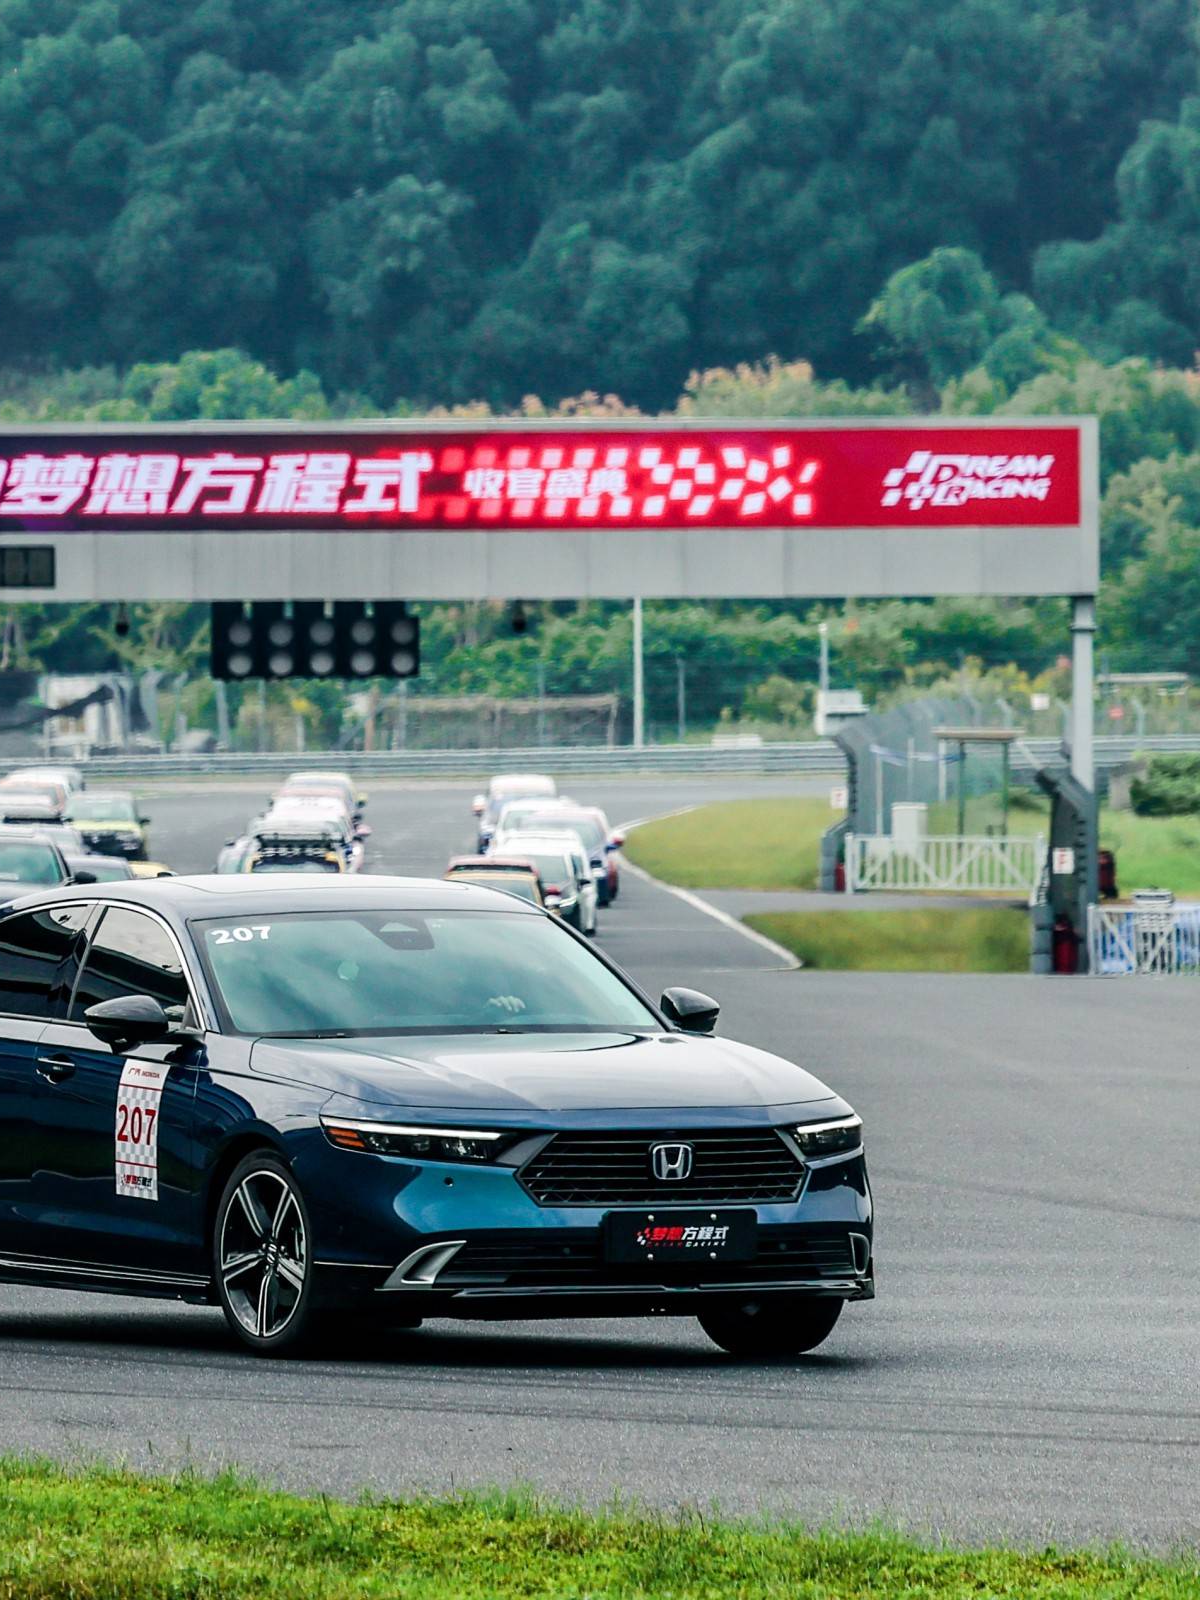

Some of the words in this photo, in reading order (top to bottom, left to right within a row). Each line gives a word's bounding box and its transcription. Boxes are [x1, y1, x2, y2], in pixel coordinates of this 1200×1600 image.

[919, 454, 1055, 482] DREAM
[930, 467, 1052, 506] RACING
[210, 926, 271, 944] 207
[116, 1103, 156, 1146] 207
